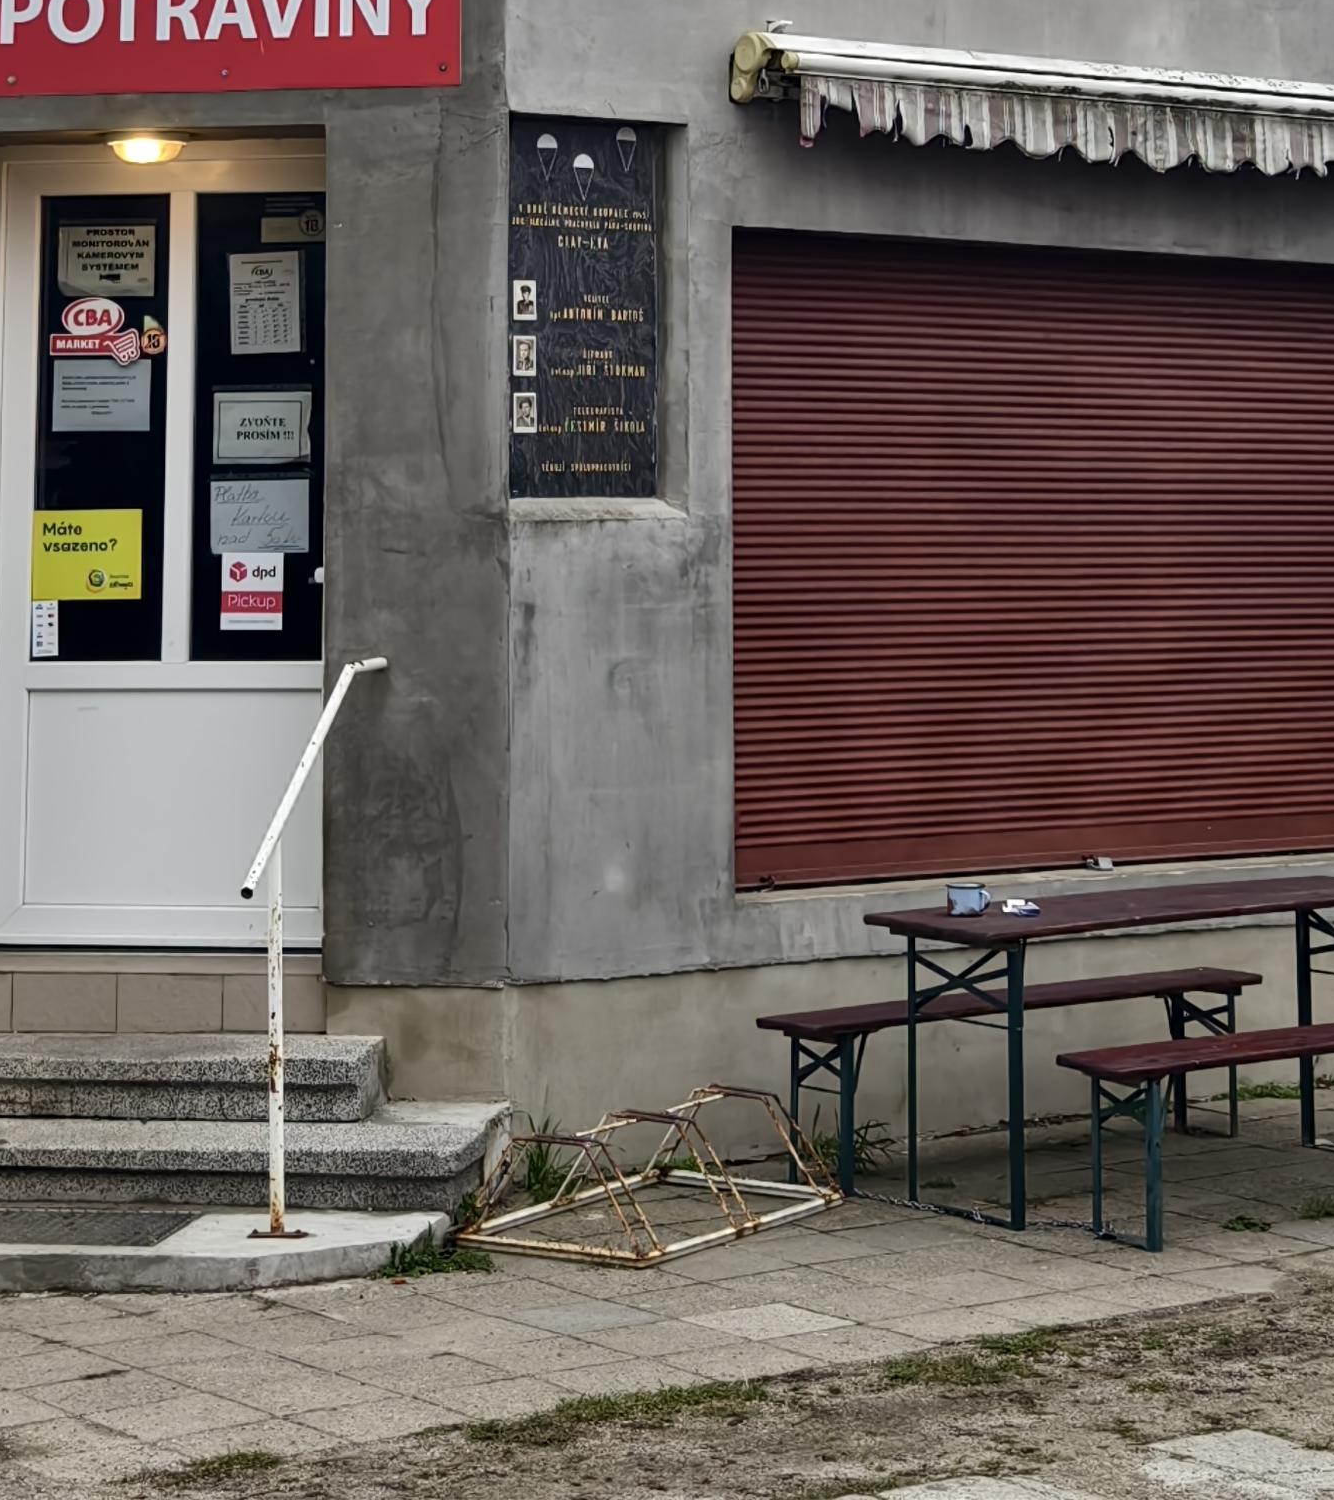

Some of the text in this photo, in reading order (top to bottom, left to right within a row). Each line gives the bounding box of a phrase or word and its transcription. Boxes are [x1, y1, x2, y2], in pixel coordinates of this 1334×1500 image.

[86, 228, 136, 236] PROSTOR
[73, 308, 113, 327] CBA
[56, 339, 101, 350] MARKET
[239, 415, 287, 428] ZVOŇTE
[236, 429, 281, 441] PROSÍM
[42, 521, 83, 537] Máte
[42, 537, 118, 553] vsazeno?
[252, 565, 277, 581] dpd
[227, 594, 276, 610] Pickup
